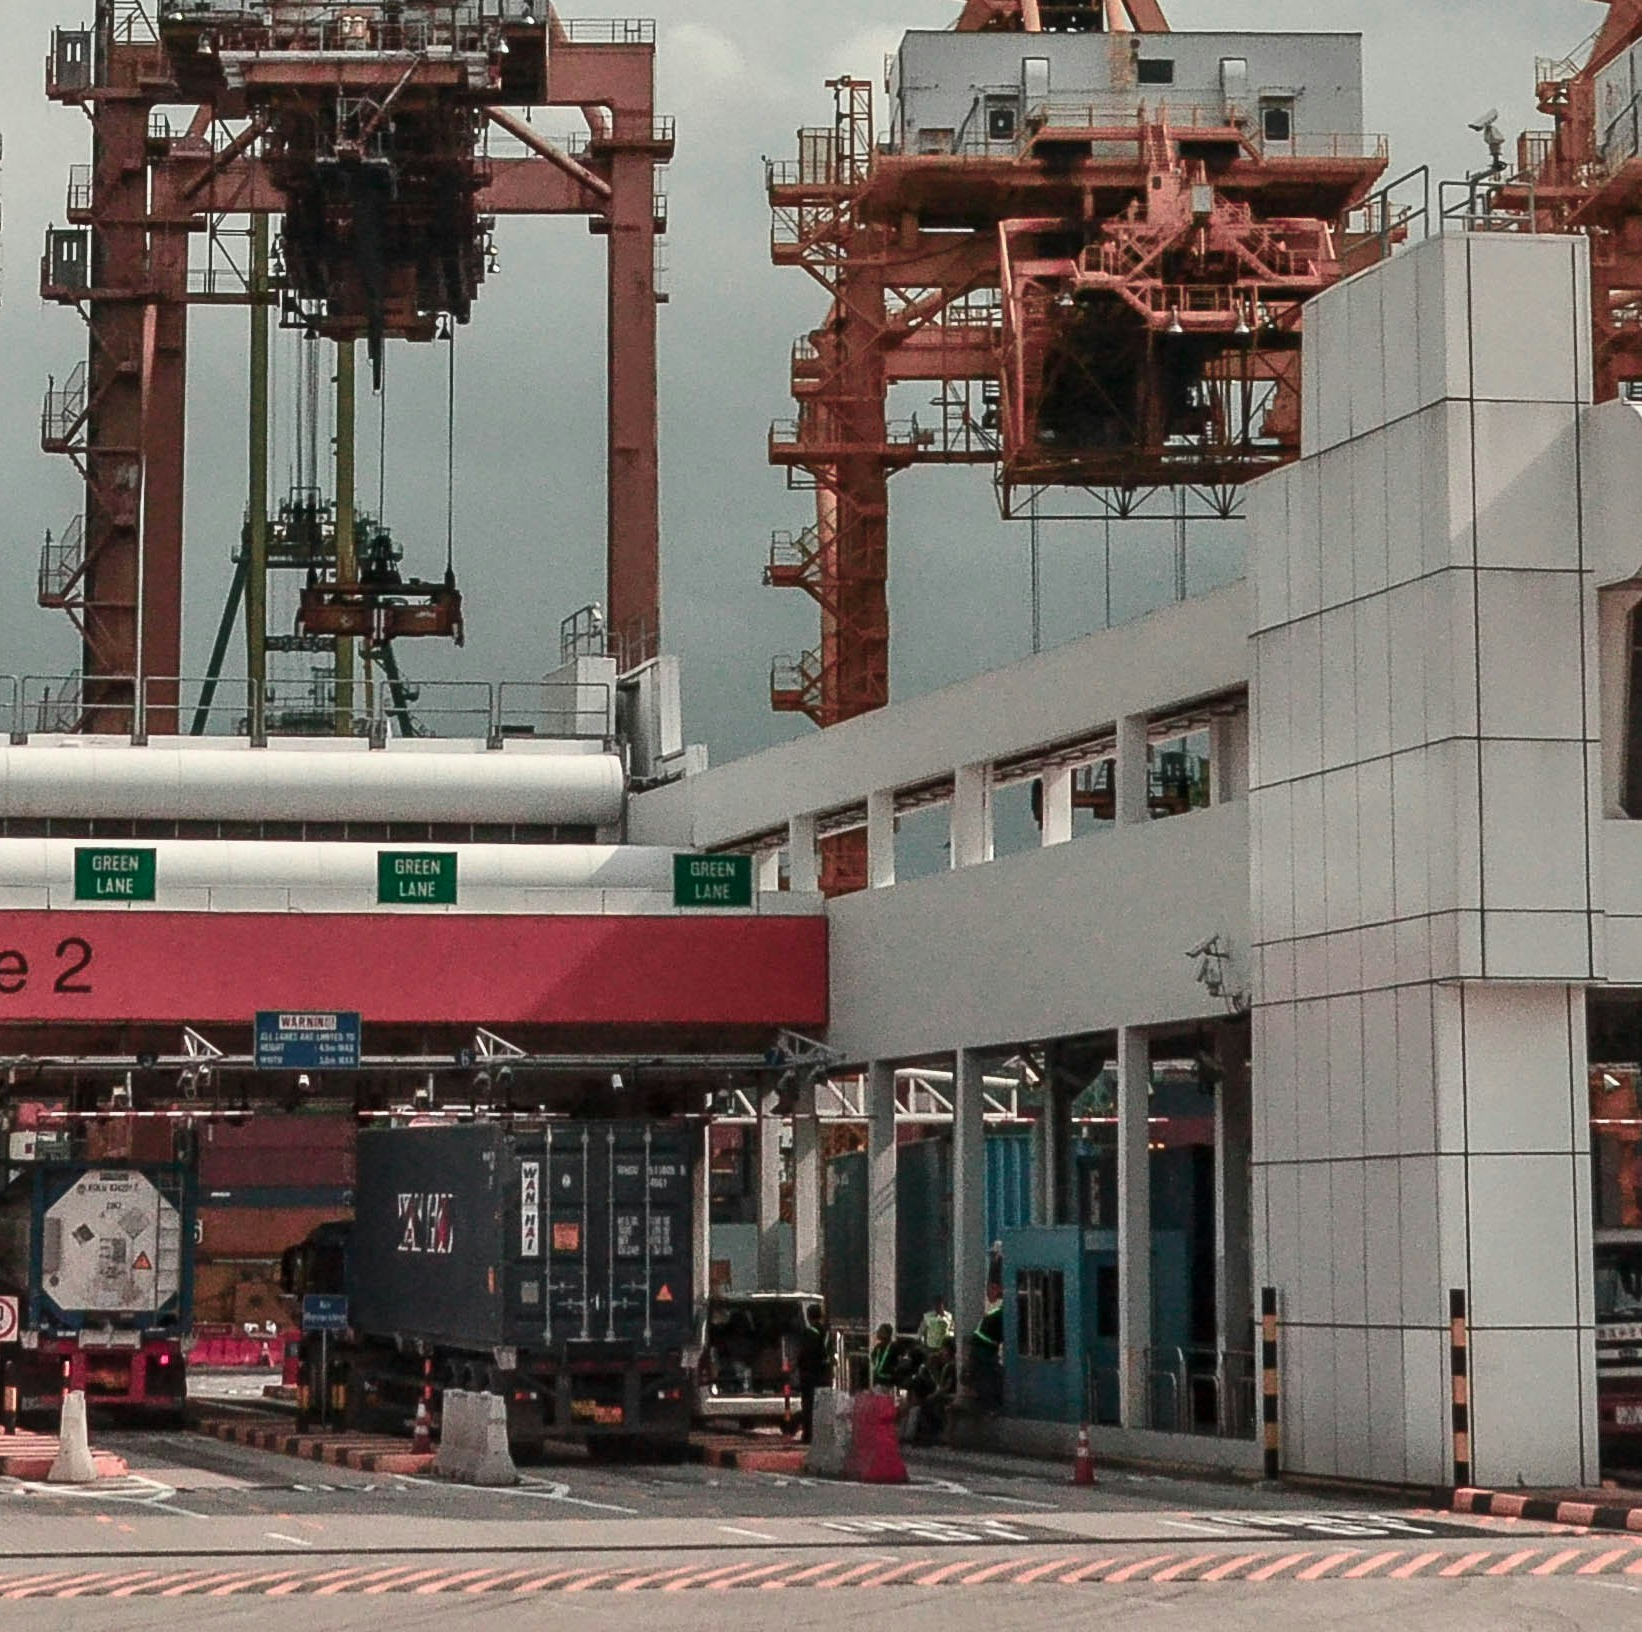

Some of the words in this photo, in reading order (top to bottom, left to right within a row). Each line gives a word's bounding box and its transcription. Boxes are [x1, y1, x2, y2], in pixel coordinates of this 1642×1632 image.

[92, 855, 139, 871] GREEN
[395, 858, 441, 875] GREEN
[690, 861, 736, 877] GREEN
[97, 877, 134, 894] LANE
[399, 881, 436, 897] LANE
[695, 884, 731, 900] LANE
[54, 936, 94, 994] 2
[281, 1015, 336, 1028] WARNING!
[523, 1167, 538, 1203] WAN
[524, 1213, 537, 1251] HAI
